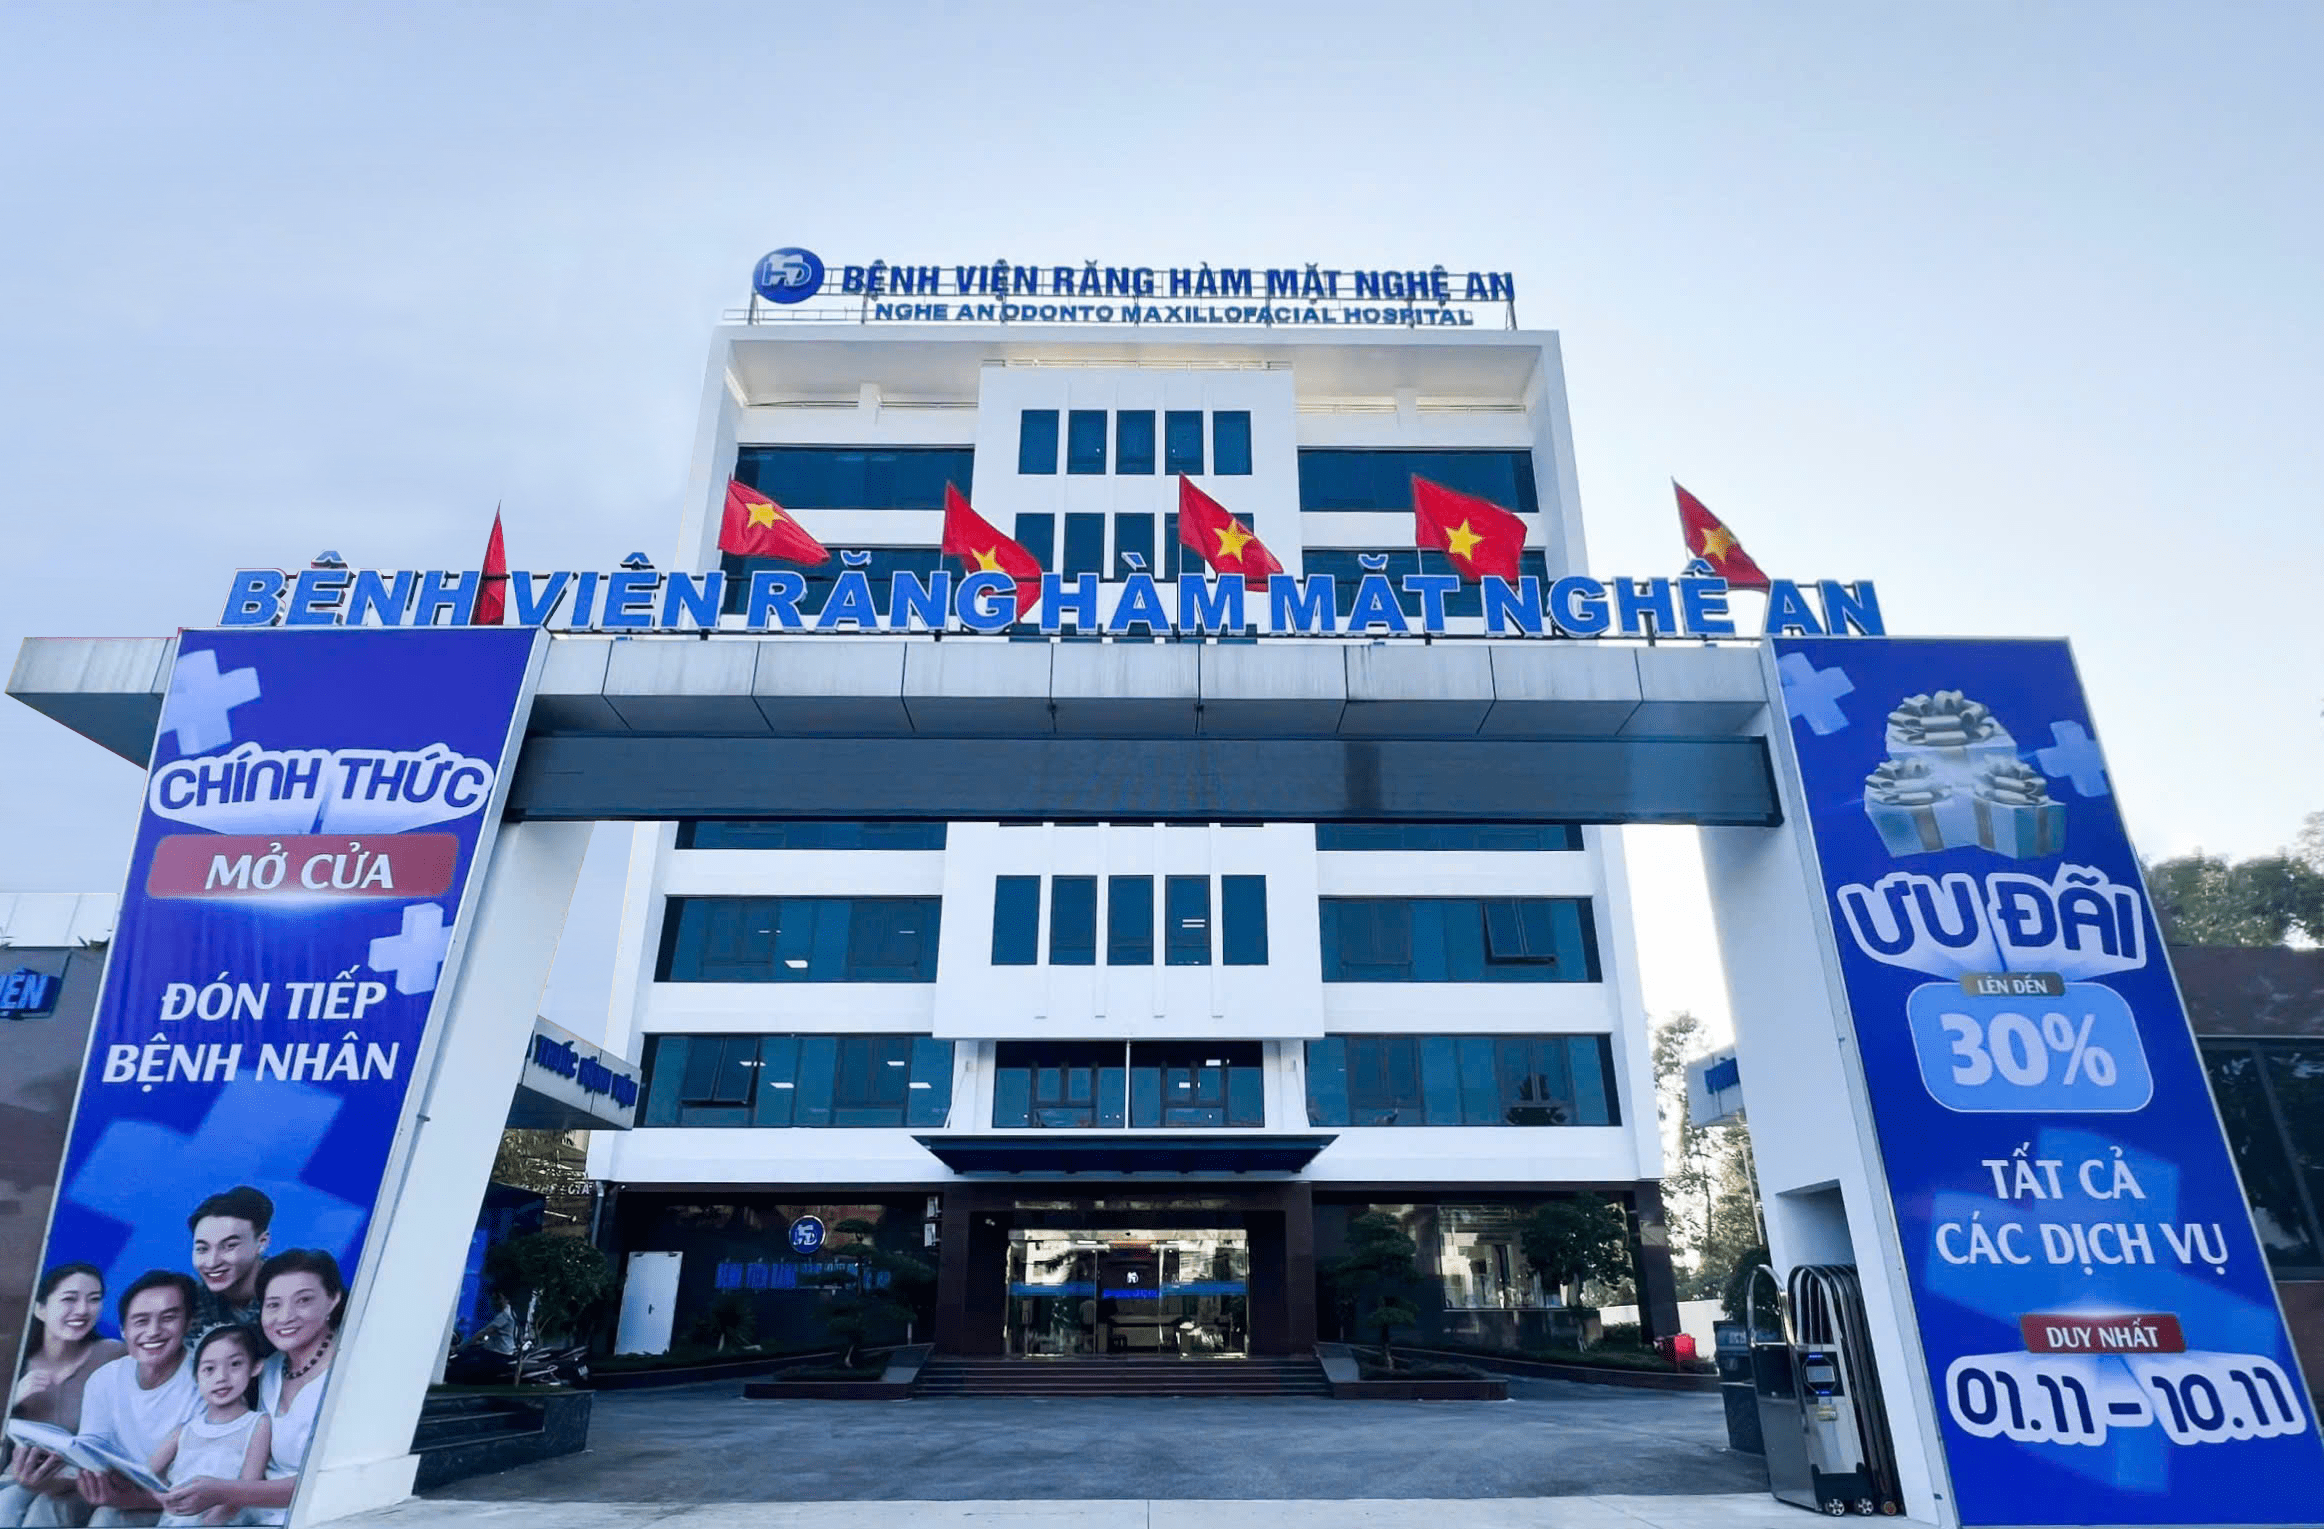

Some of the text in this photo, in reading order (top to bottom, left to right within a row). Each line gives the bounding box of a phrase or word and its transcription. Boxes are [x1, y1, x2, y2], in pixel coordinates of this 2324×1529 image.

[842, 258, 1516, 307] BỆNH VIỆN RĂNG HÀM MẶT NGHỆ AN
[875, 303, 1474, 327] NGHE AN ODONTO MAXILLOFACIAL HOSPITAL
[746, 550, 1018, 634] RĂNG
[1040, 552, 1247, 634] HÀM
[1761, 579, 1887, 636] AN
[159, 750, 485, 810] CHÍNH THỨC
[204, 841, 395, 890] MỞ CỬA
[1846, 871, 2138, 960] ƯU ĐÃI
[160, 965, 388, 1021] ĐÓN TIẾP
[102, 1031, 400, 1092] BỆNH NHÂN
[1939, 1012, 2118, 1087] 30%
[1981, 1142, 2146, 1200] TẤT CẢ
[1935, 1211, 2229, 1276] CÁC DỊCH VỤ
[2045, 1318, 2159, 1348] DUY NHẤT
[1956, 1367, 2096, 1434] 01.11
[2151, 1366, 2295, 1434] 10.11
